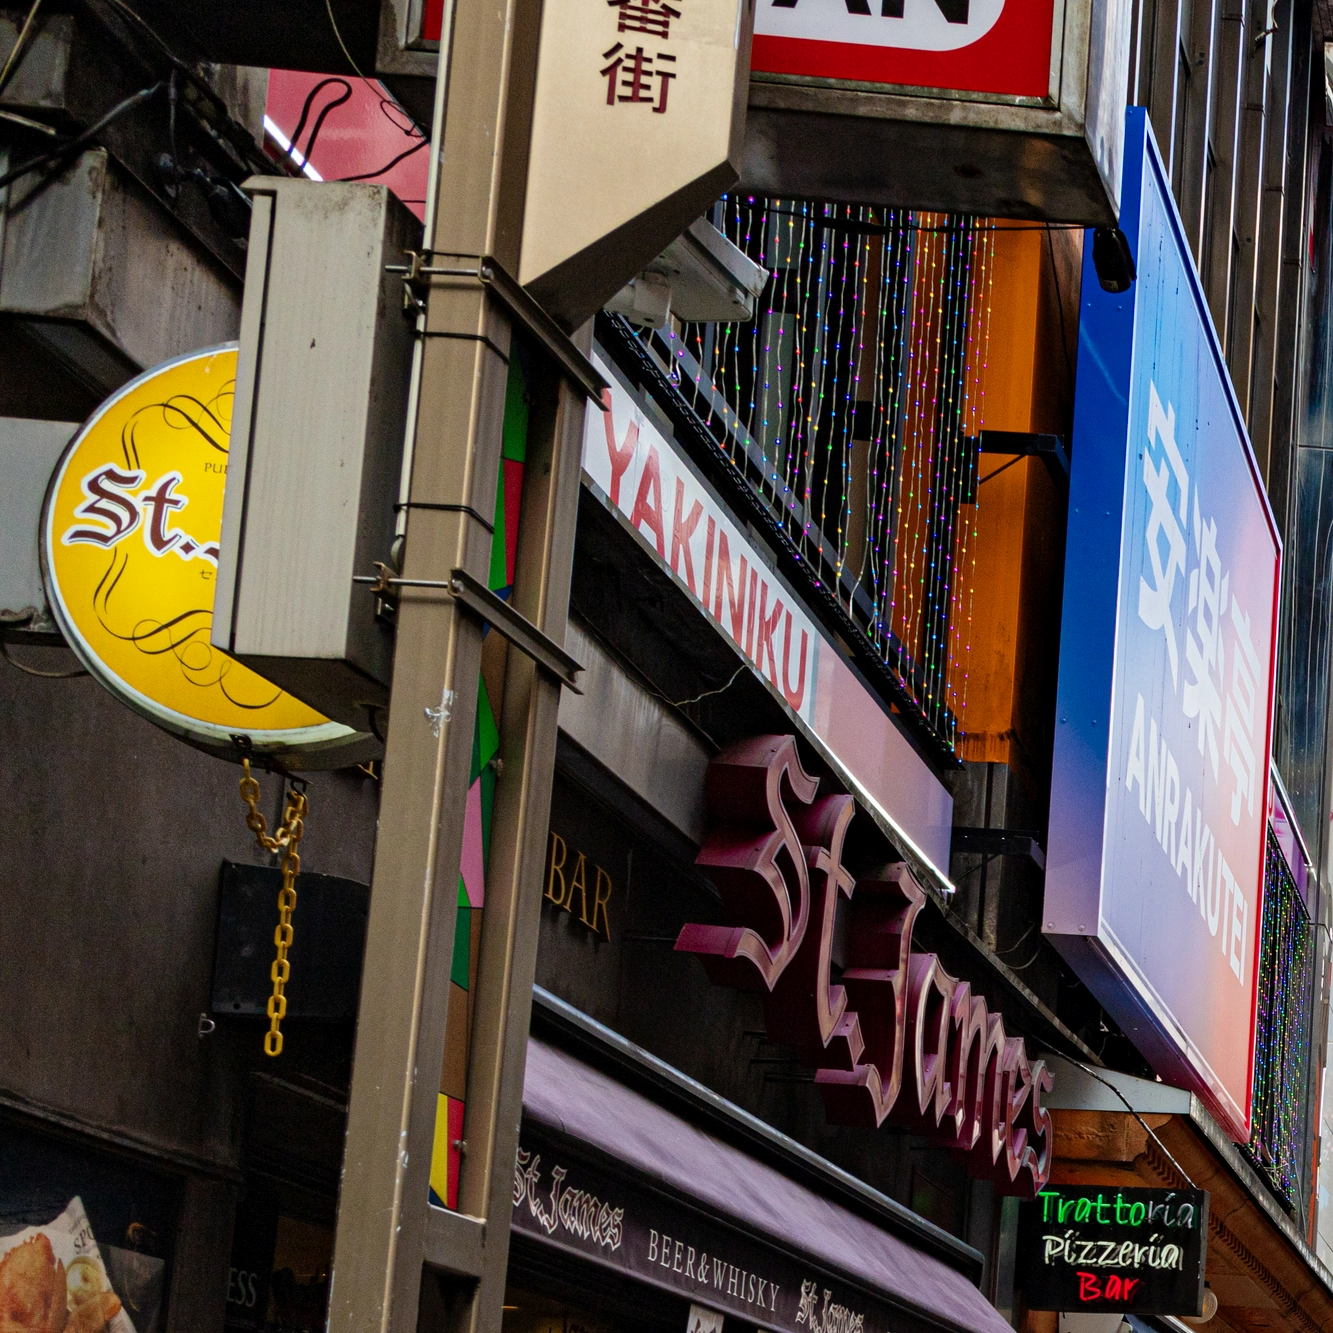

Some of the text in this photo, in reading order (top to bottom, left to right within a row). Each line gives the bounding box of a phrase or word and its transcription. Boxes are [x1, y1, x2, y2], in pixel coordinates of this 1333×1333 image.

[600, 387, 810, 712] YAKINIKU
[1125, 694, 1250, 988] ANRAKUTEI
[1039, 1192, 1195, 1229] Trattoria
[1043, 1230, 1183, 1270] Pizzeria
[1076, 1271, 1140, 1301] Bar
